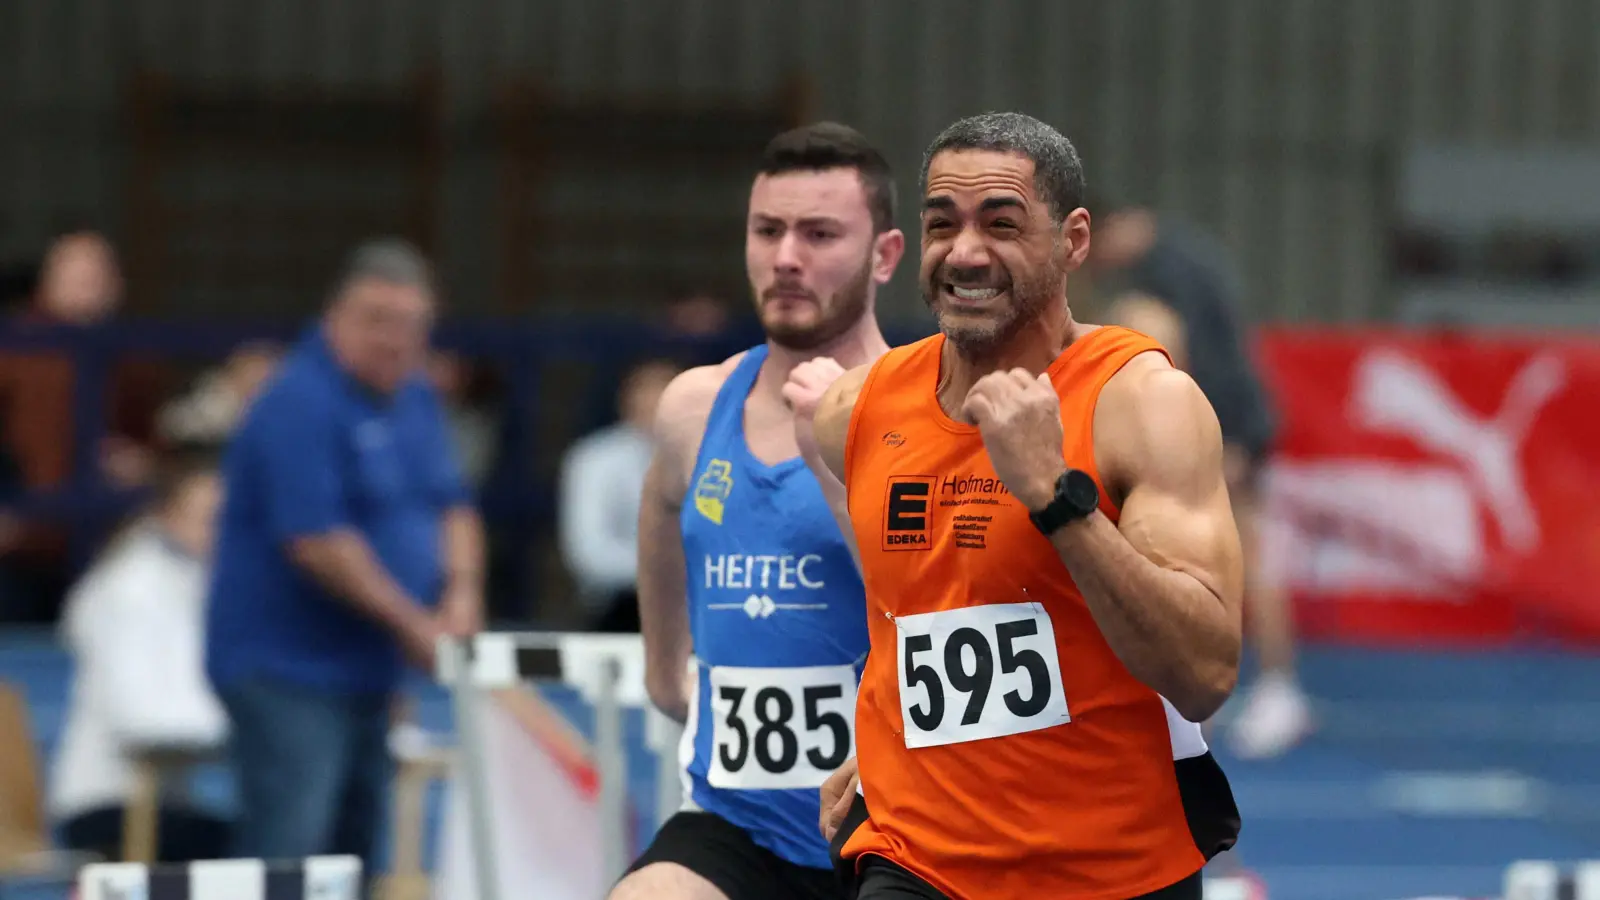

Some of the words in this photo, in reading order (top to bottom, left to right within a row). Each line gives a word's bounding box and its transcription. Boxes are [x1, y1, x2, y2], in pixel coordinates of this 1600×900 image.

[941, 474, 1009, 495] Hofman
[887, 482, 930, 531] E
[887, 534, 927, 545] EDEKA
[704, 553, 825, 590] HEITEC
[904, 618, 1052, 731] 595
[718, 683, 850, 774] 385
